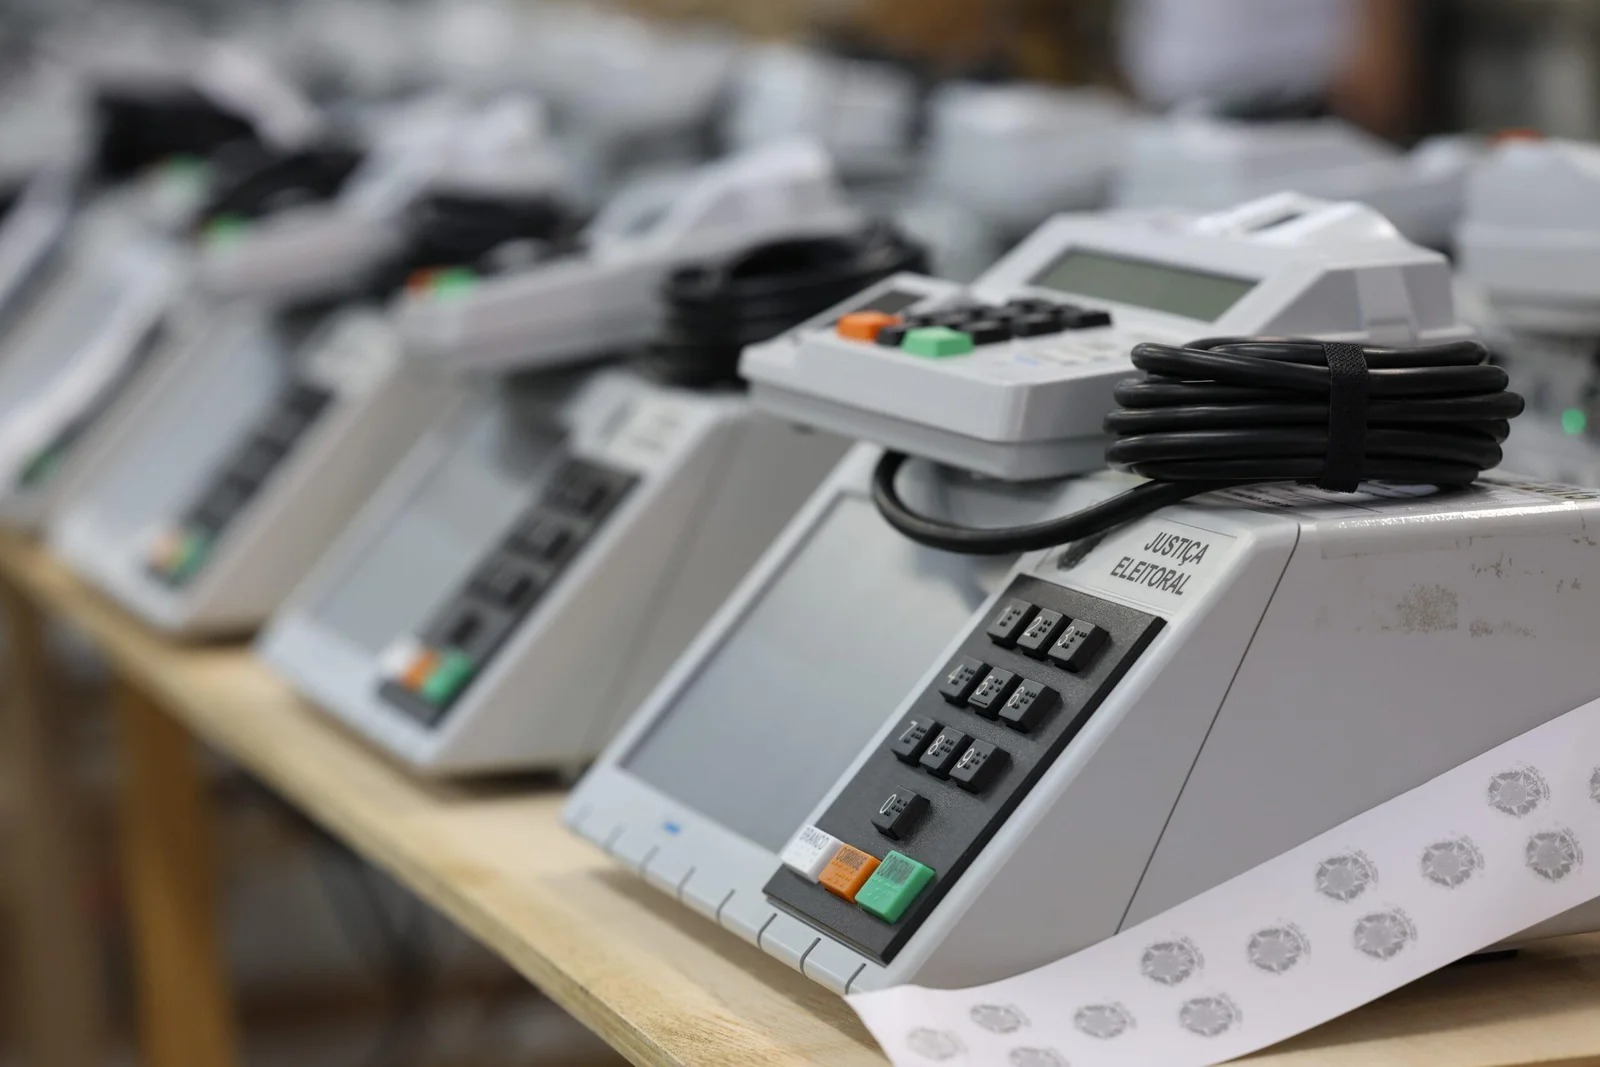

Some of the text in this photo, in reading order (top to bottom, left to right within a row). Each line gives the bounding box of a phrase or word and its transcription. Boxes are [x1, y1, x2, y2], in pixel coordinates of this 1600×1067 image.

[1144, 532, 1209, 566] JUSTIÇA
[1110, 556, 1191, 595] ELEITORAL
[1023, 616, 1043, 637] 2
[1057, 626, 1075, 646] 3
[947, 663, 1025, 706] 4 5 6
[899, 720, 975, 768] 7 8 9
[879, 794, 897, 814] 0
